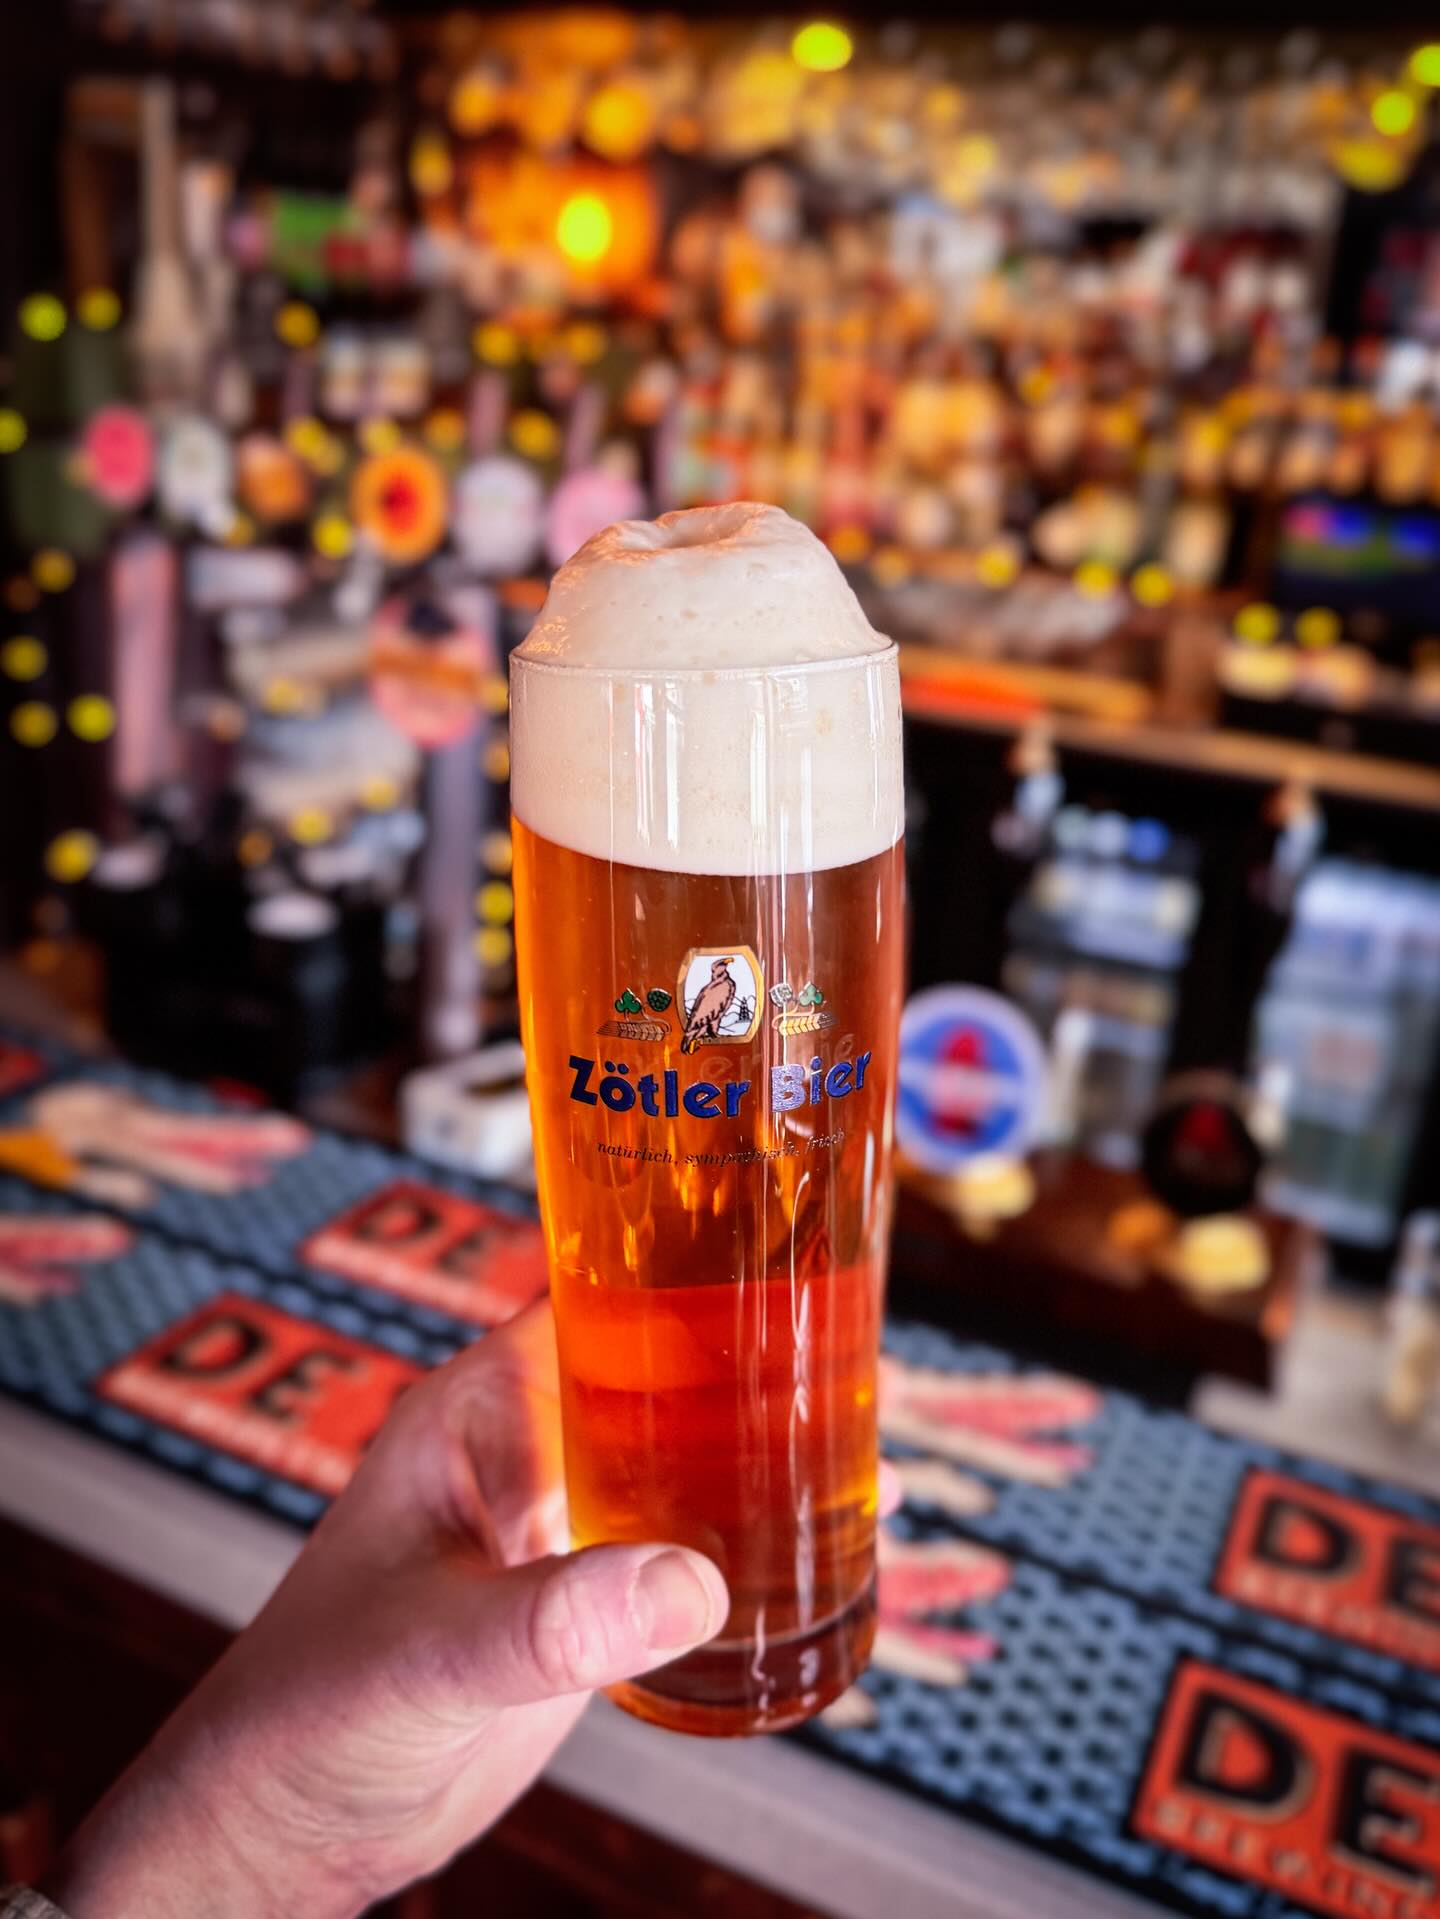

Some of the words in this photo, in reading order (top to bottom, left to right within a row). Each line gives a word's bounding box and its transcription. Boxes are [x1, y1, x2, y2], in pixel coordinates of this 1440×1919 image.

[568, 1055, 749, 1118] Zötler
[770, 1051, 872, 1113] Bier
[157, 1317, 402, 1450] DE
[1175, 1690, 1440, 1895] DE
